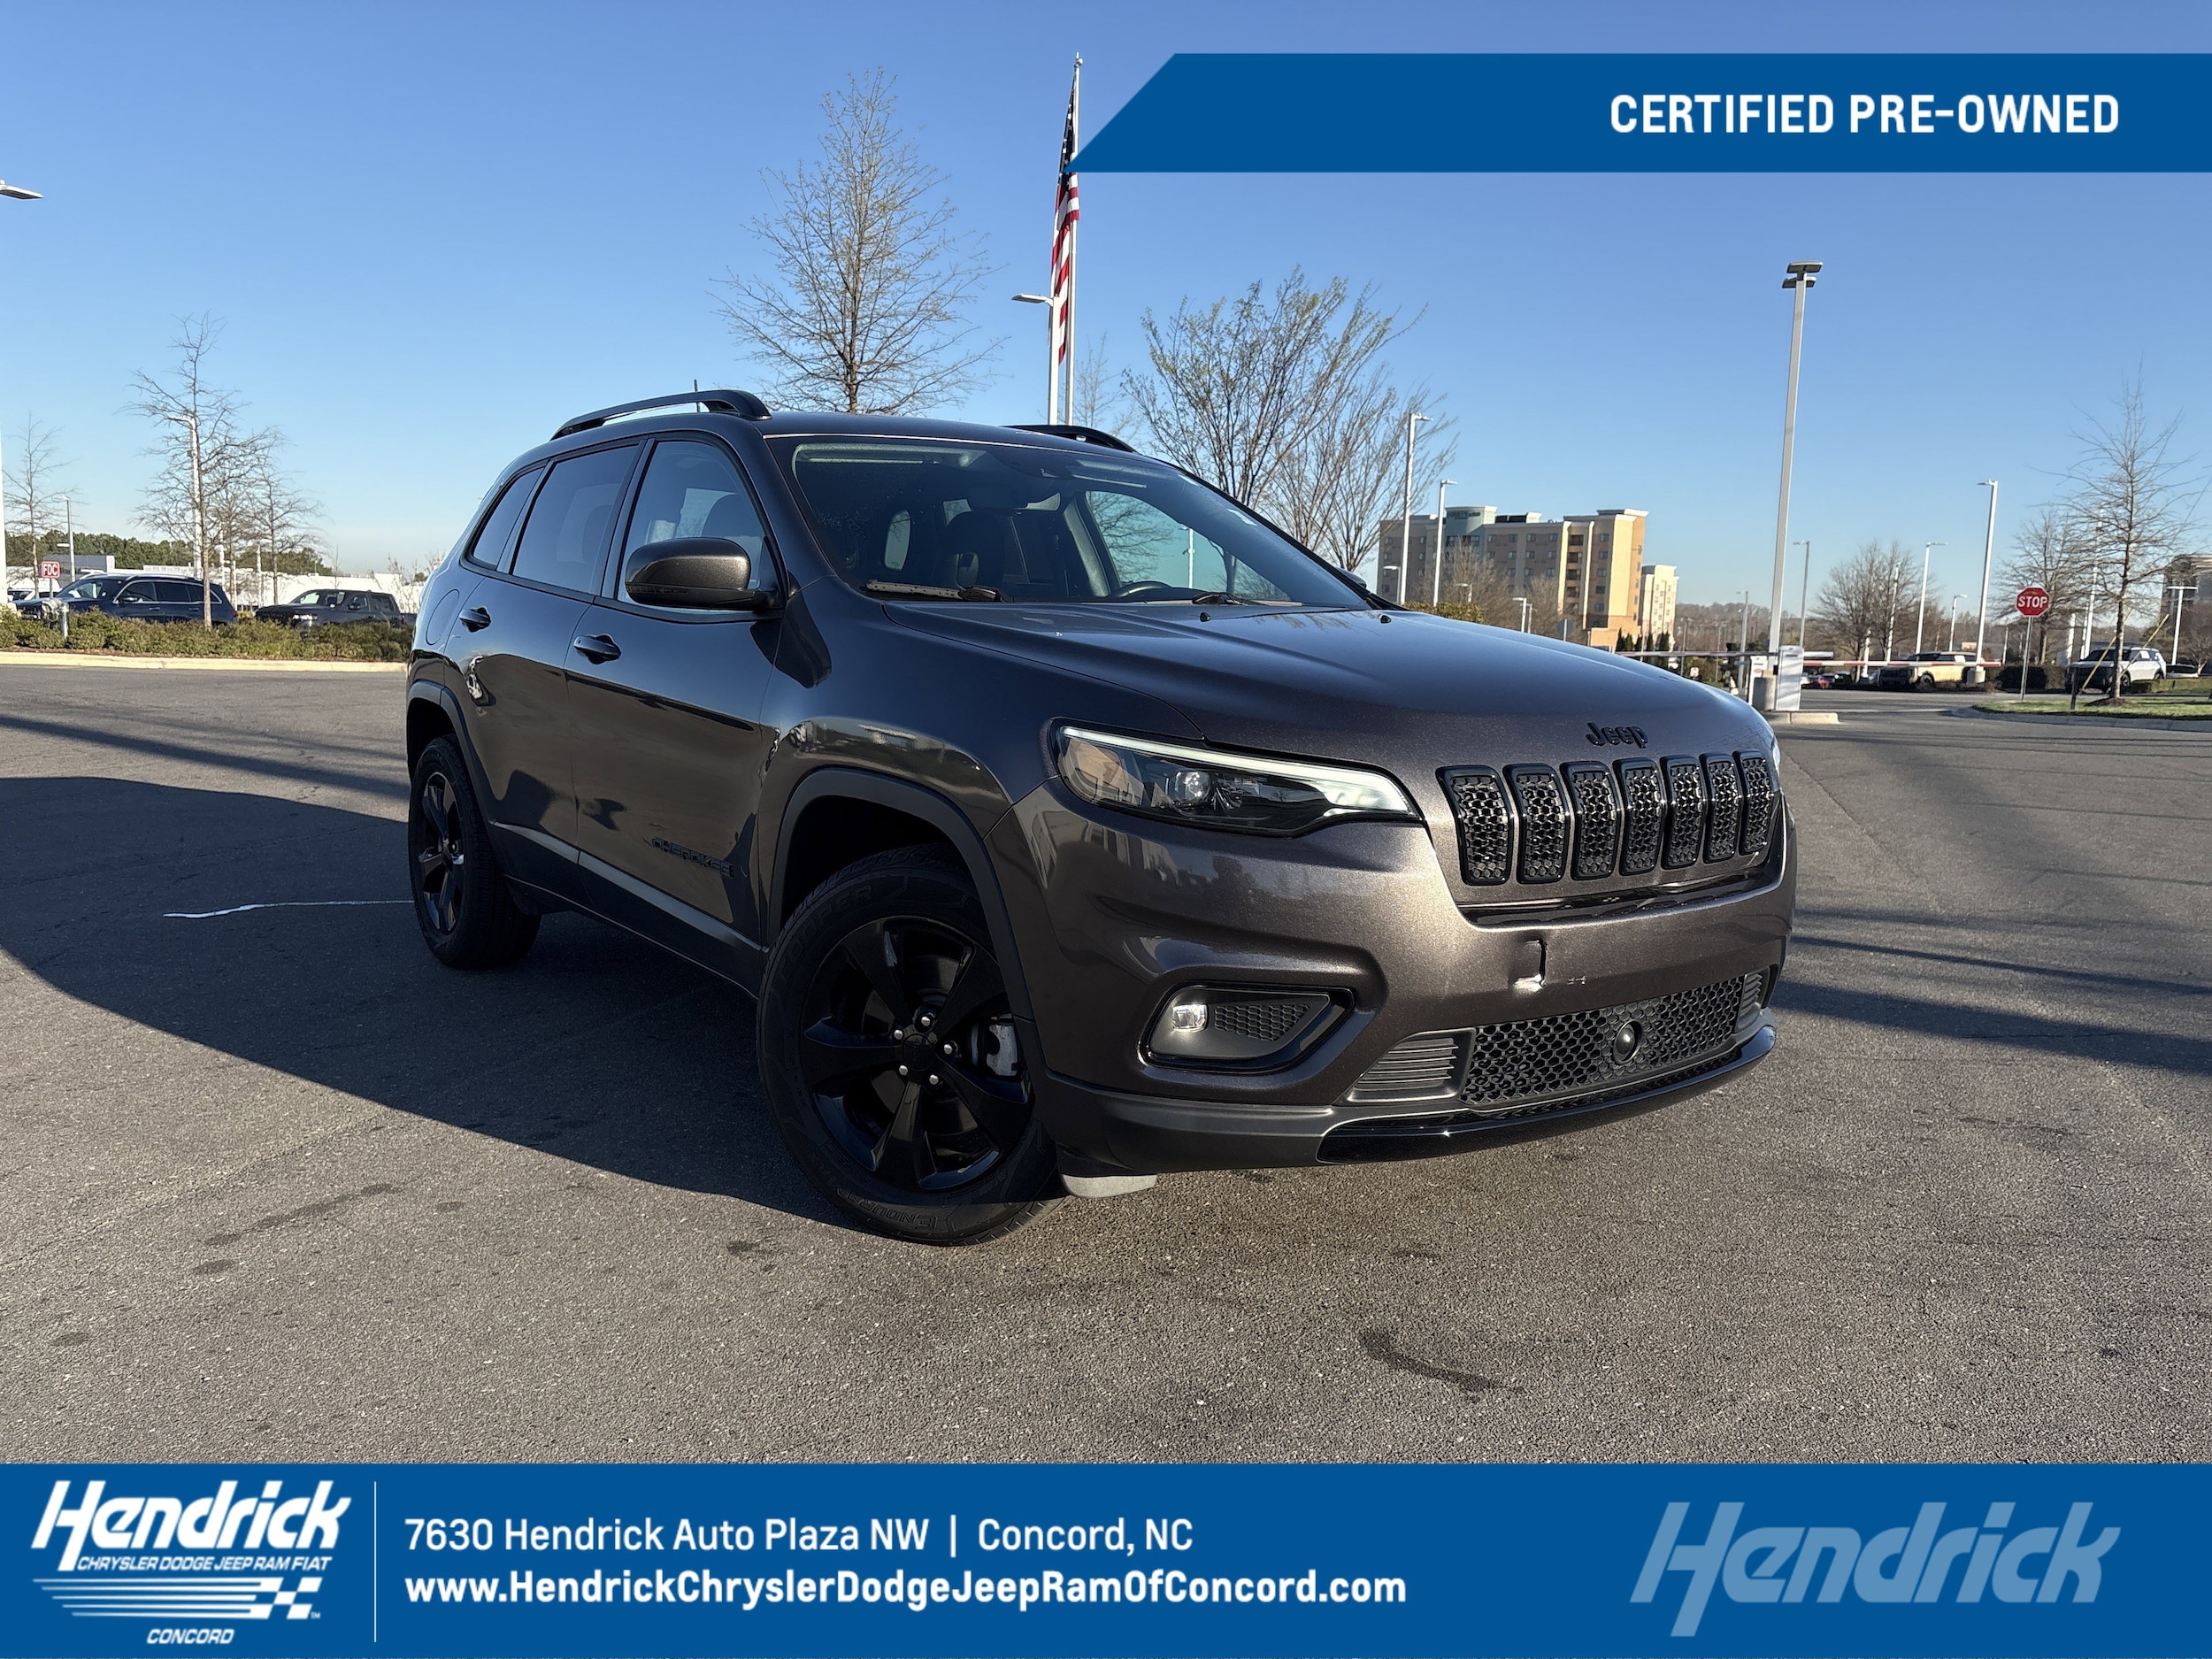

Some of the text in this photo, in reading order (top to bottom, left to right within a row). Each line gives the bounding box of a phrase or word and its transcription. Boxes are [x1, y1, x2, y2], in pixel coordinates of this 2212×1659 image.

[43, 564, 58, 575] FDC
[2017, 595, 2048, 608] STOP
[1586, 722, 1647, 749] Jeep
[651, 836, 734, 877] CHEROKEE
